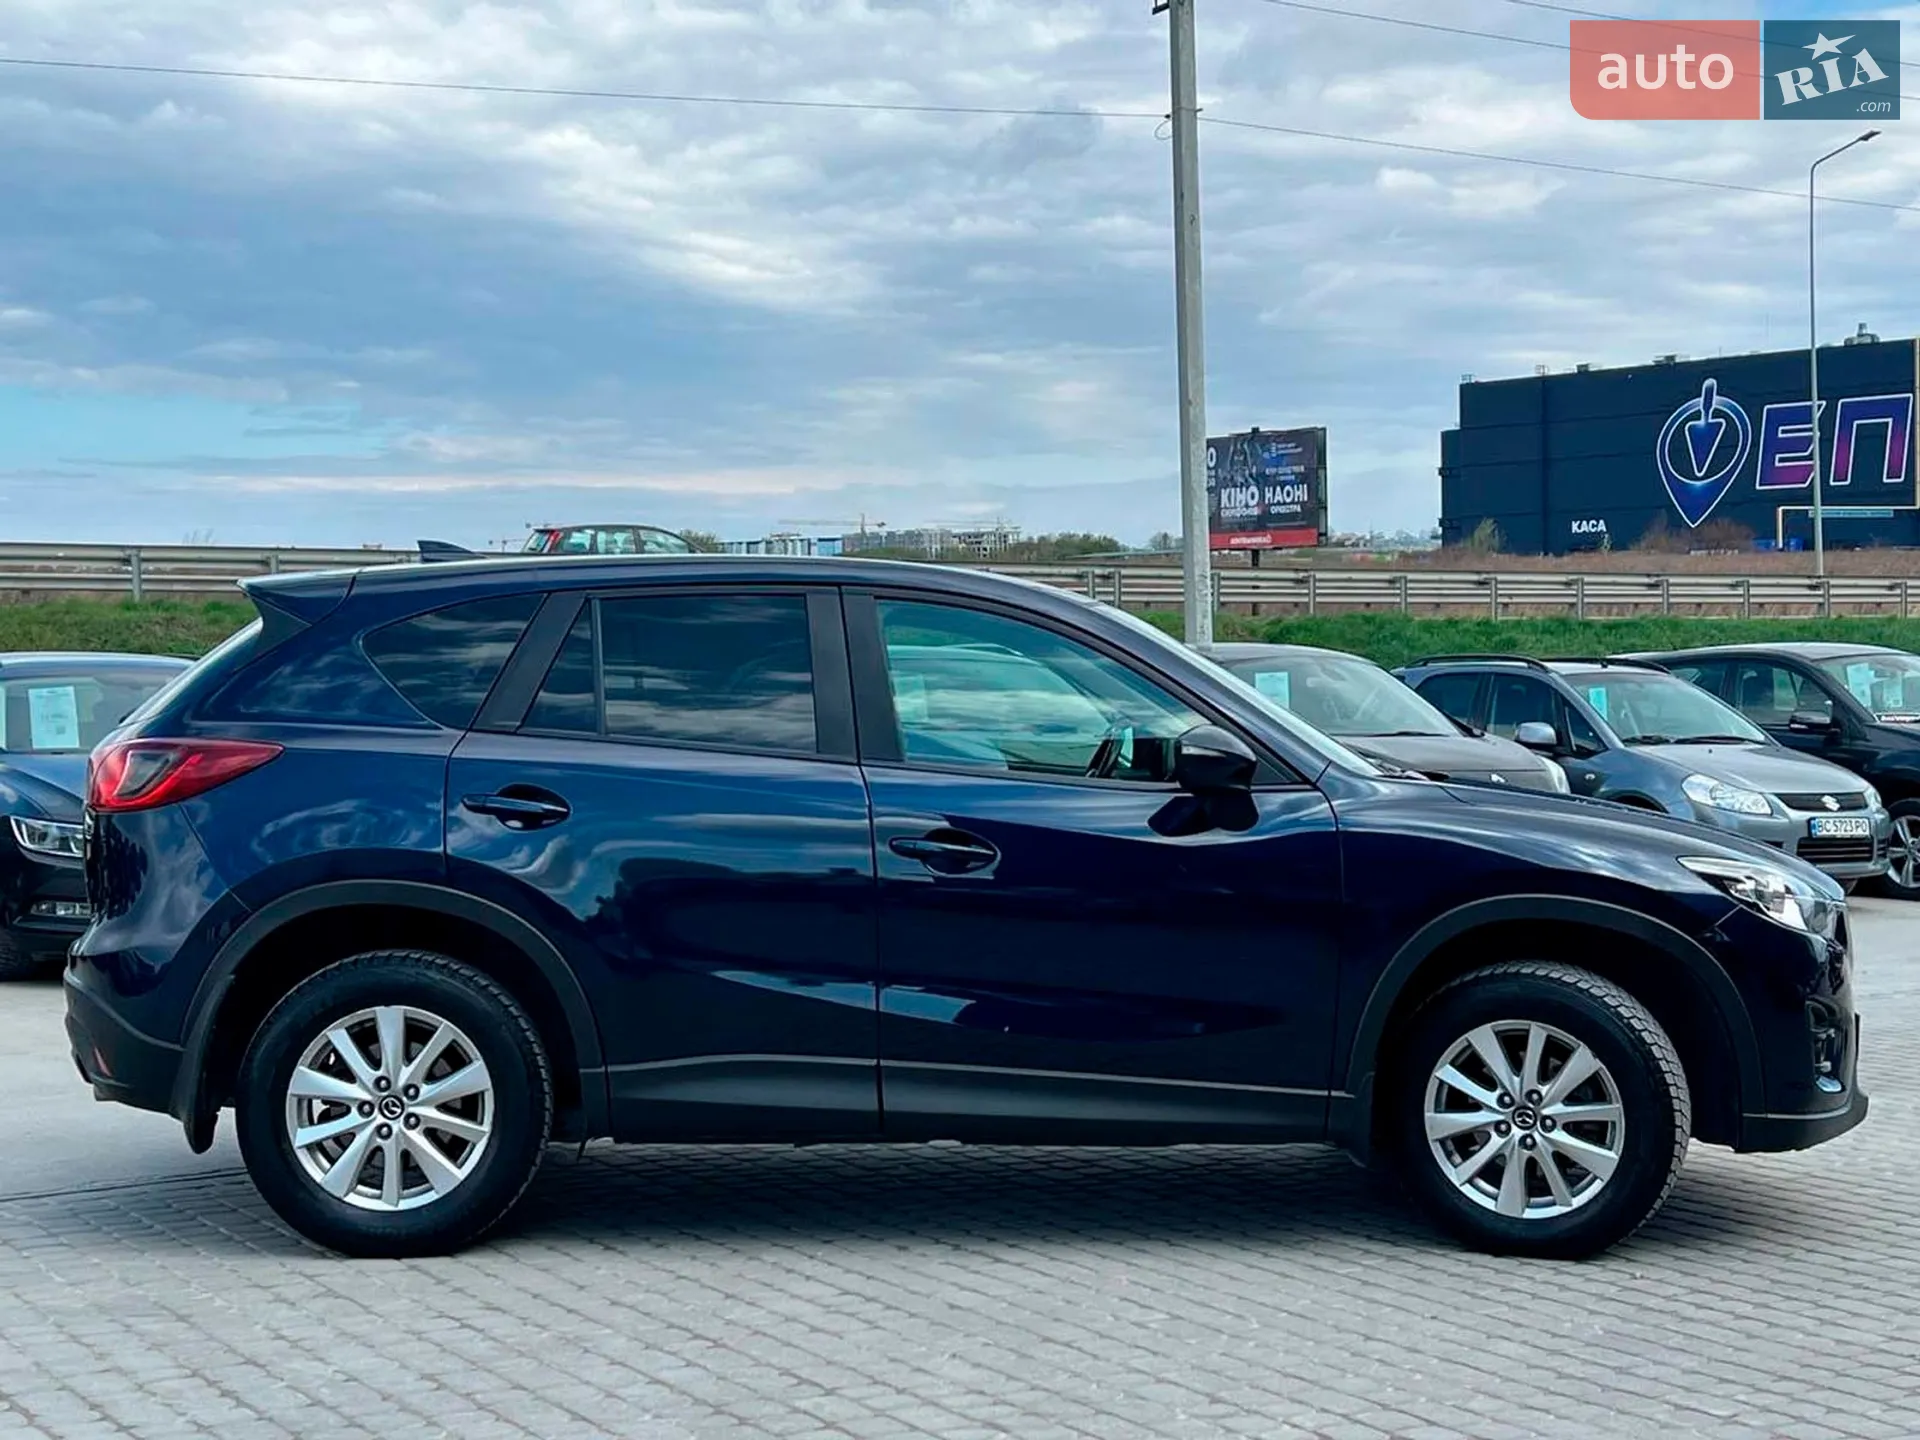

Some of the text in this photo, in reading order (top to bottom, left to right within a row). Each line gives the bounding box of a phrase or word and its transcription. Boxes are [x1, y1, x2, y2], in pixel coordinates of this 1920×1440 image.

[1221, 485, 1260, 508] КІНО
[1265, 484, 1308, 504] НАОНІ
[1571, 519, 1607, 533] КАСА
[1818, 820, 1831, 833] BC
[1832, 820, 1854, 833] 5723
